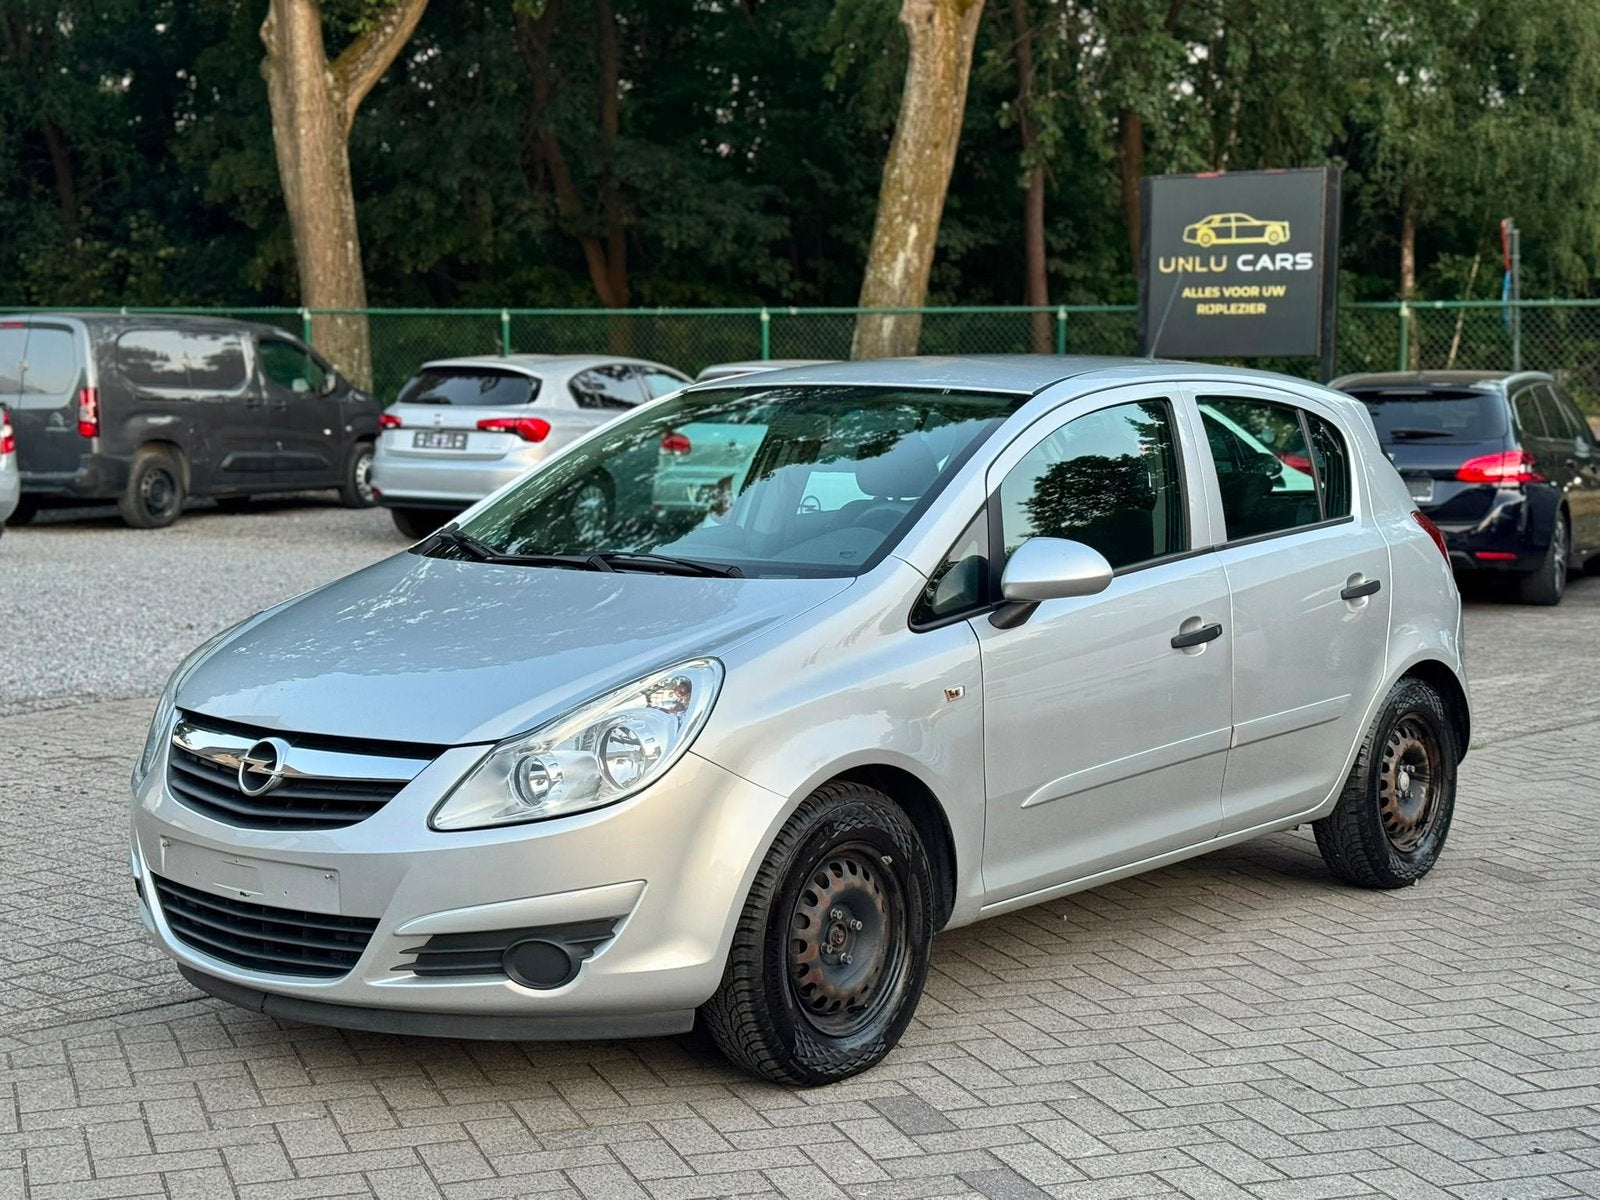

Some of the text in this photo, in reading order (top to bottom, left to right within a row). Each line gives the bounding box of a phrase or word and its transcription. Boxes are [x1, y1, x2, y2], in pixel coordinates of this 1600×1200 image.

[1158, 252, 1314, 273] UNLU CARS
[1181, 285, 1287, 298] ALLES VOOR UW
